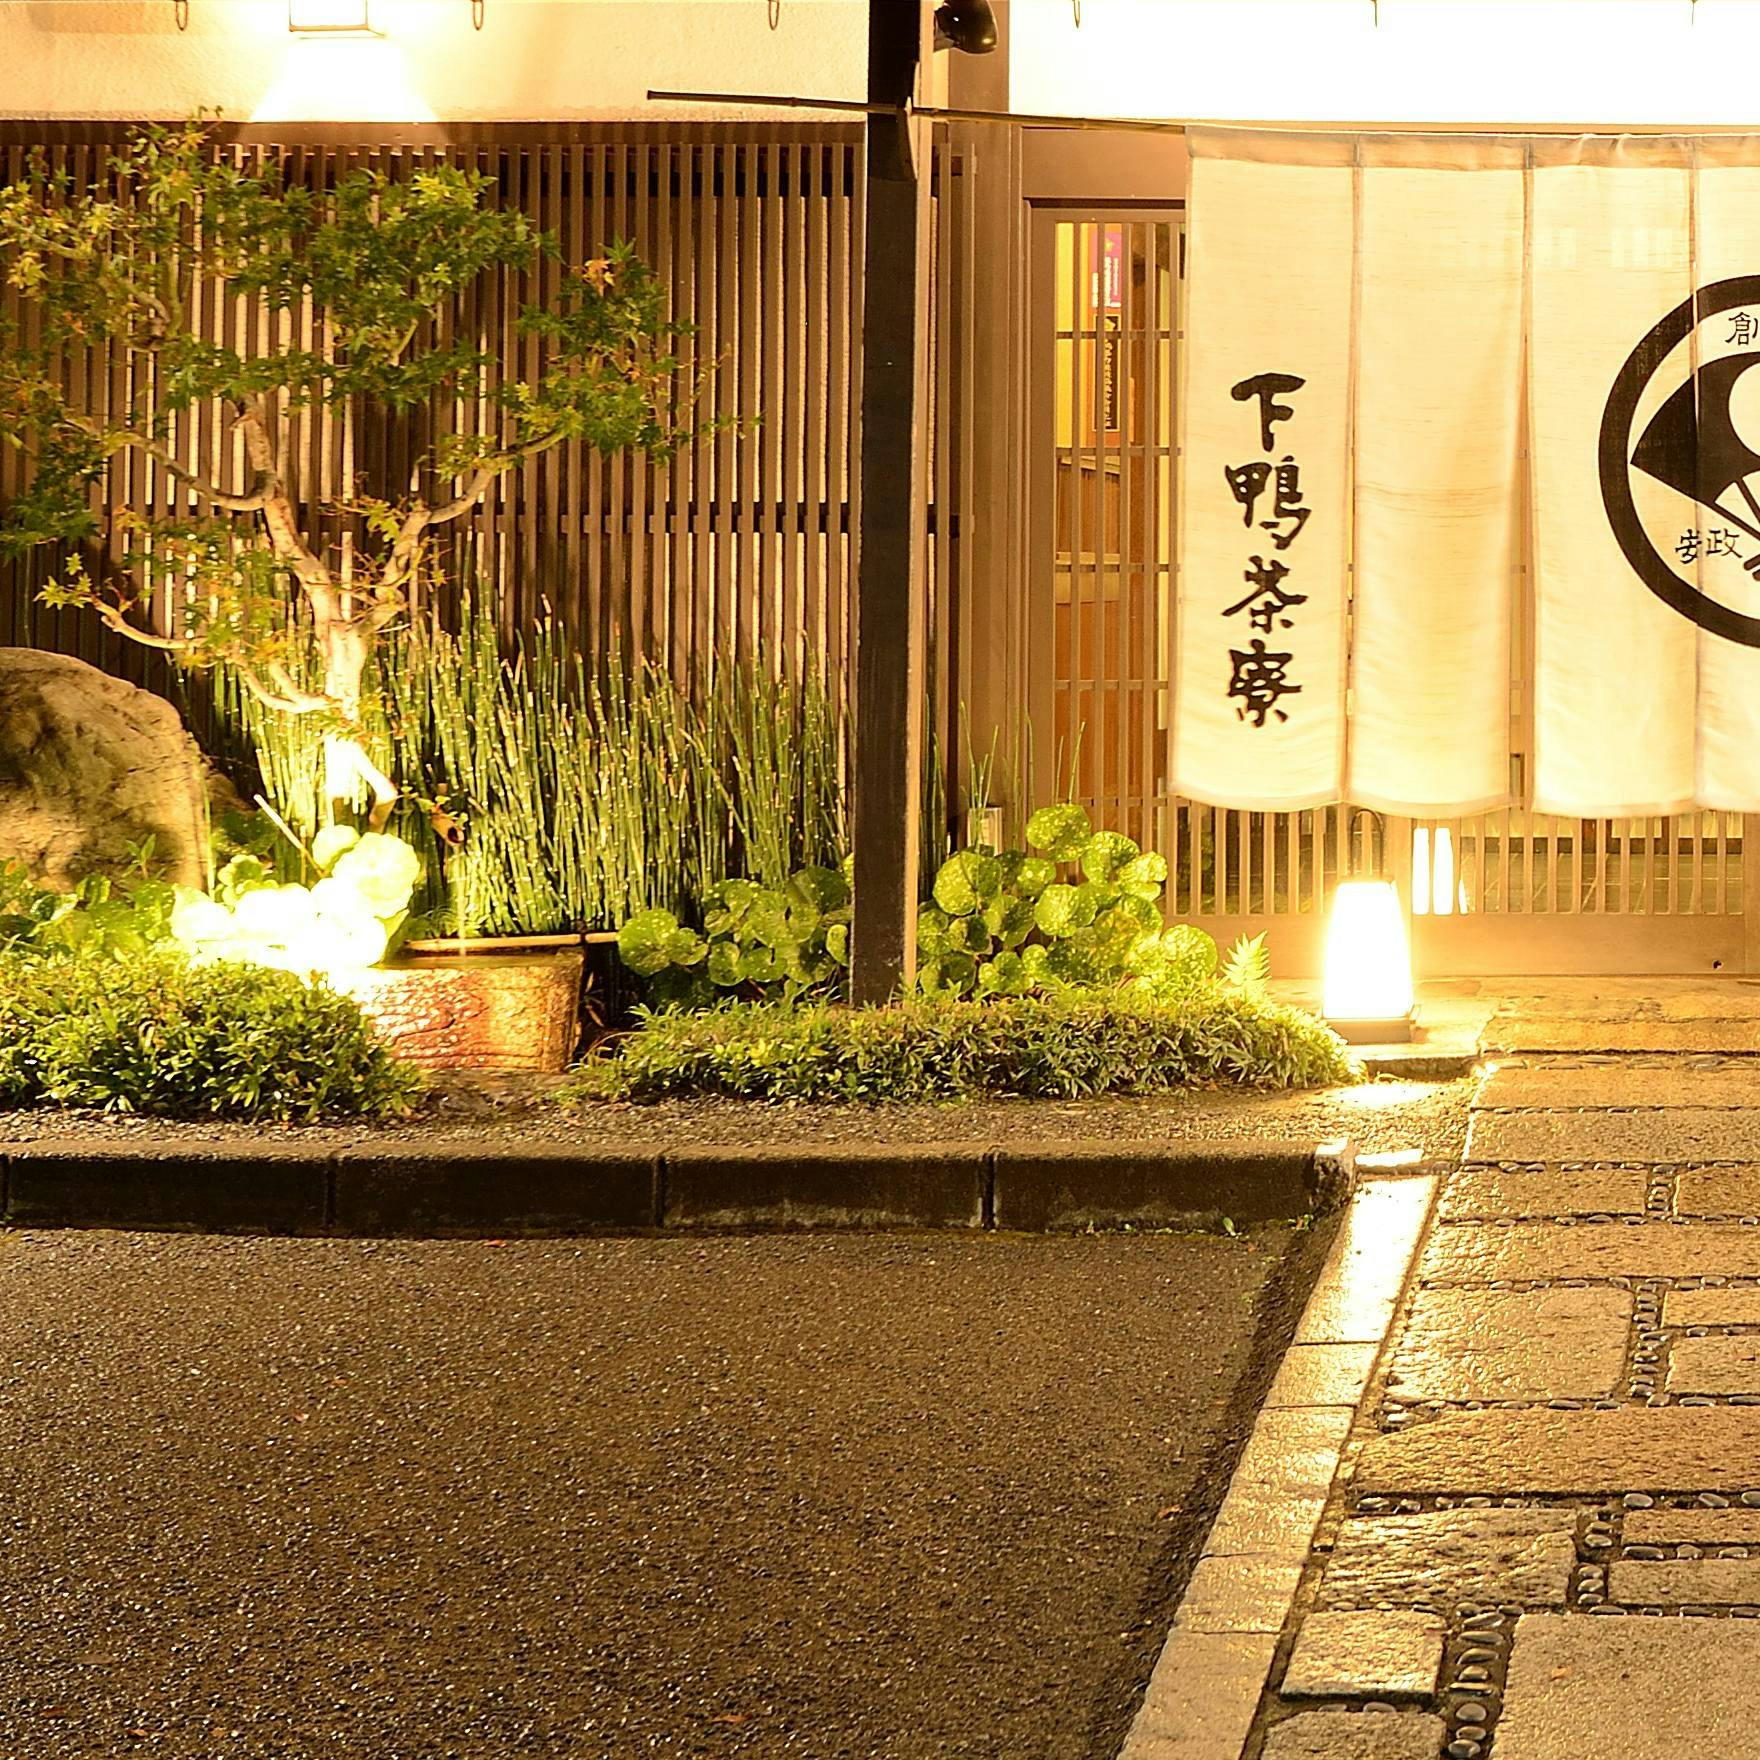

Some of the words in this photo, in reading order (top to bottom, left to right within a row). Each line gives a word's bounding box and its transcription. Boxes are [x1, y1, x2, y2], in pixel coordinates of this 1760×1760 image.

[1222, 372, 1312, 728] 下鴨茶寮
[1675, 528, 1744, 564] 安政
